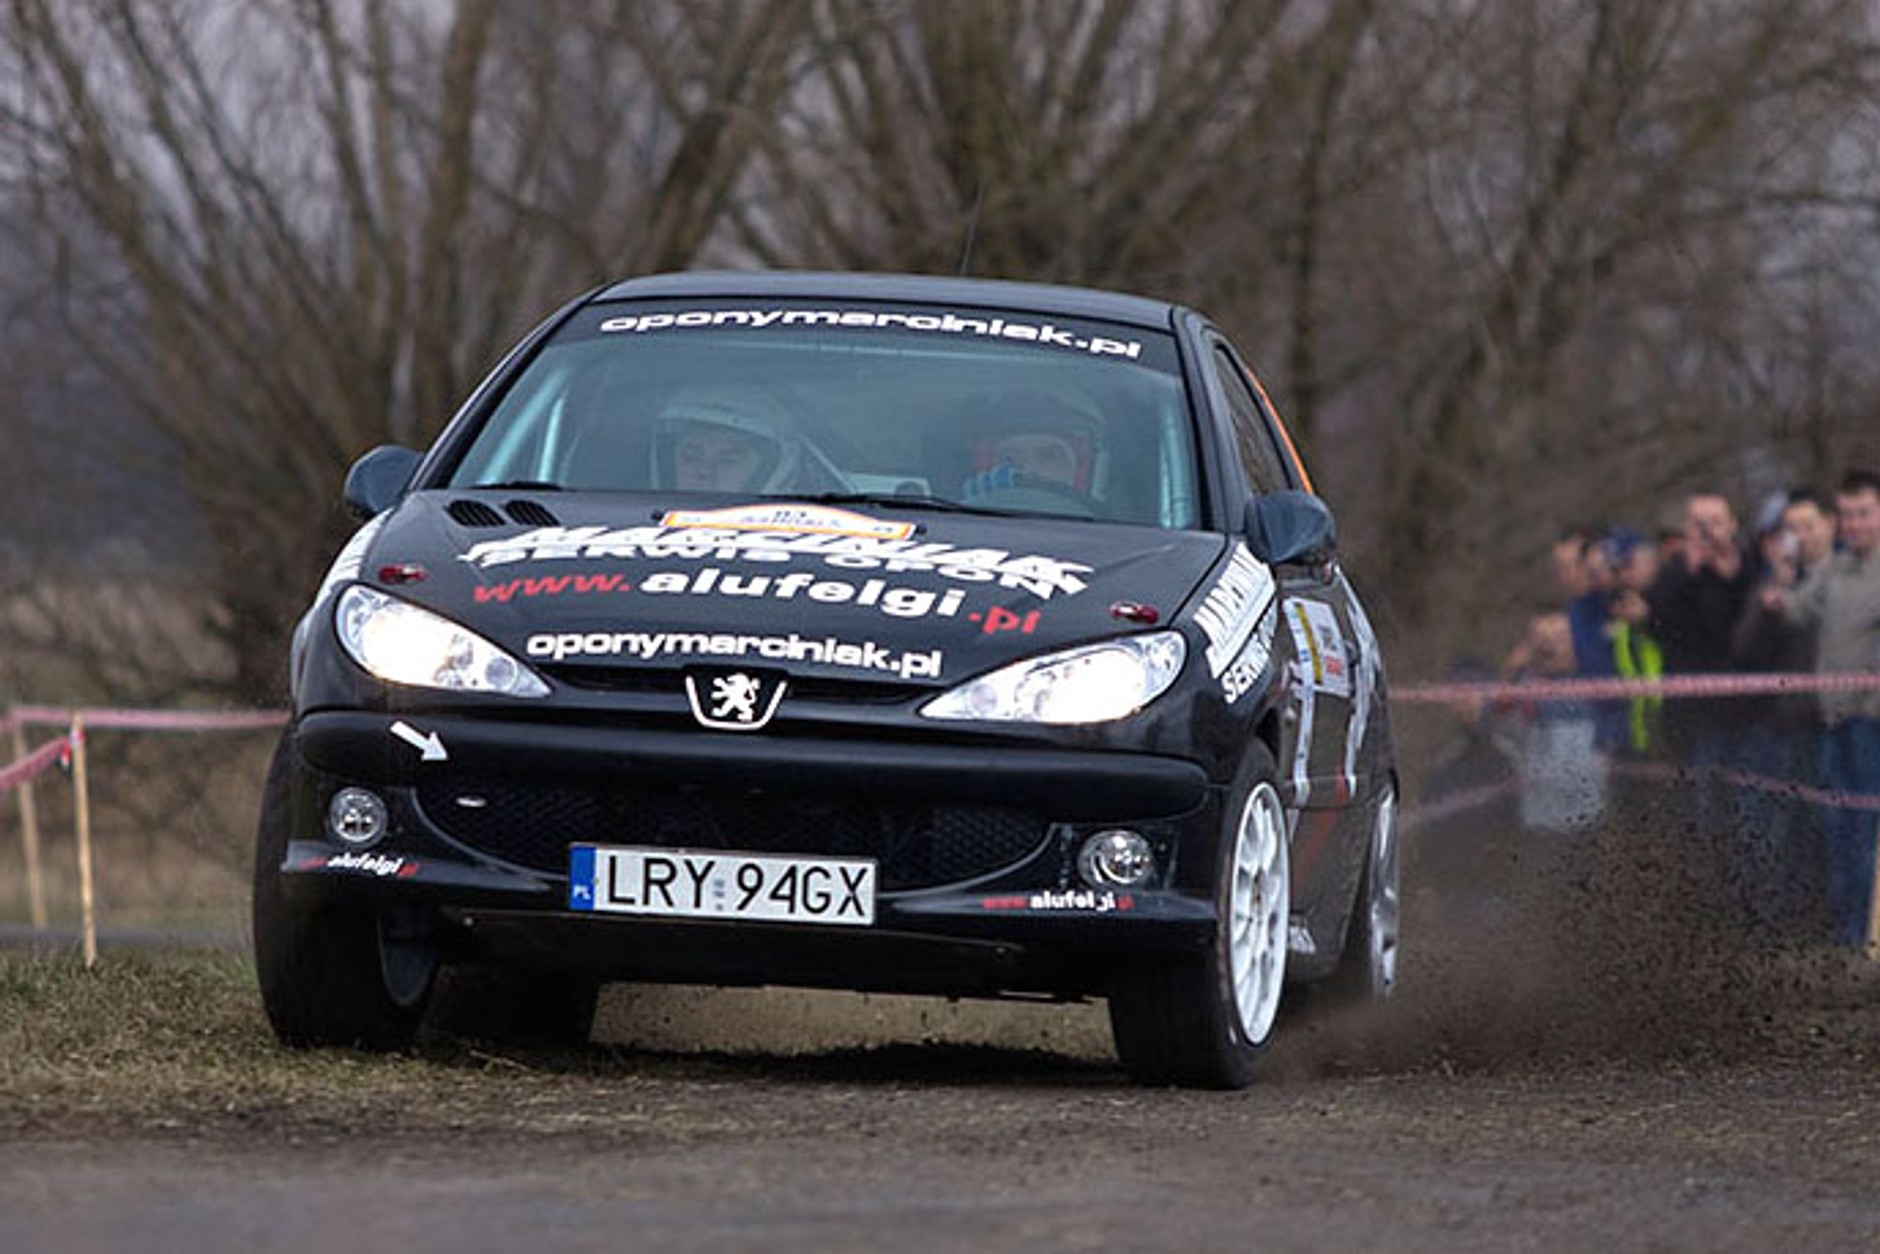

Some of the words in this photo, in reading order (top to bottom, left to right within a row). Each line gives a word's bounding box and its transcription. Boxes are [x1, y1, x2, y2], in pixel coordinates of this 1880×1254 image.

[600, 310, 1142, 359] oponymarciniak.pl
[526, 632, 943, 679] oponymarciniak.pl
[607, 855, 715, 909] LRY
[735, 861, 869, 917] 94GX
